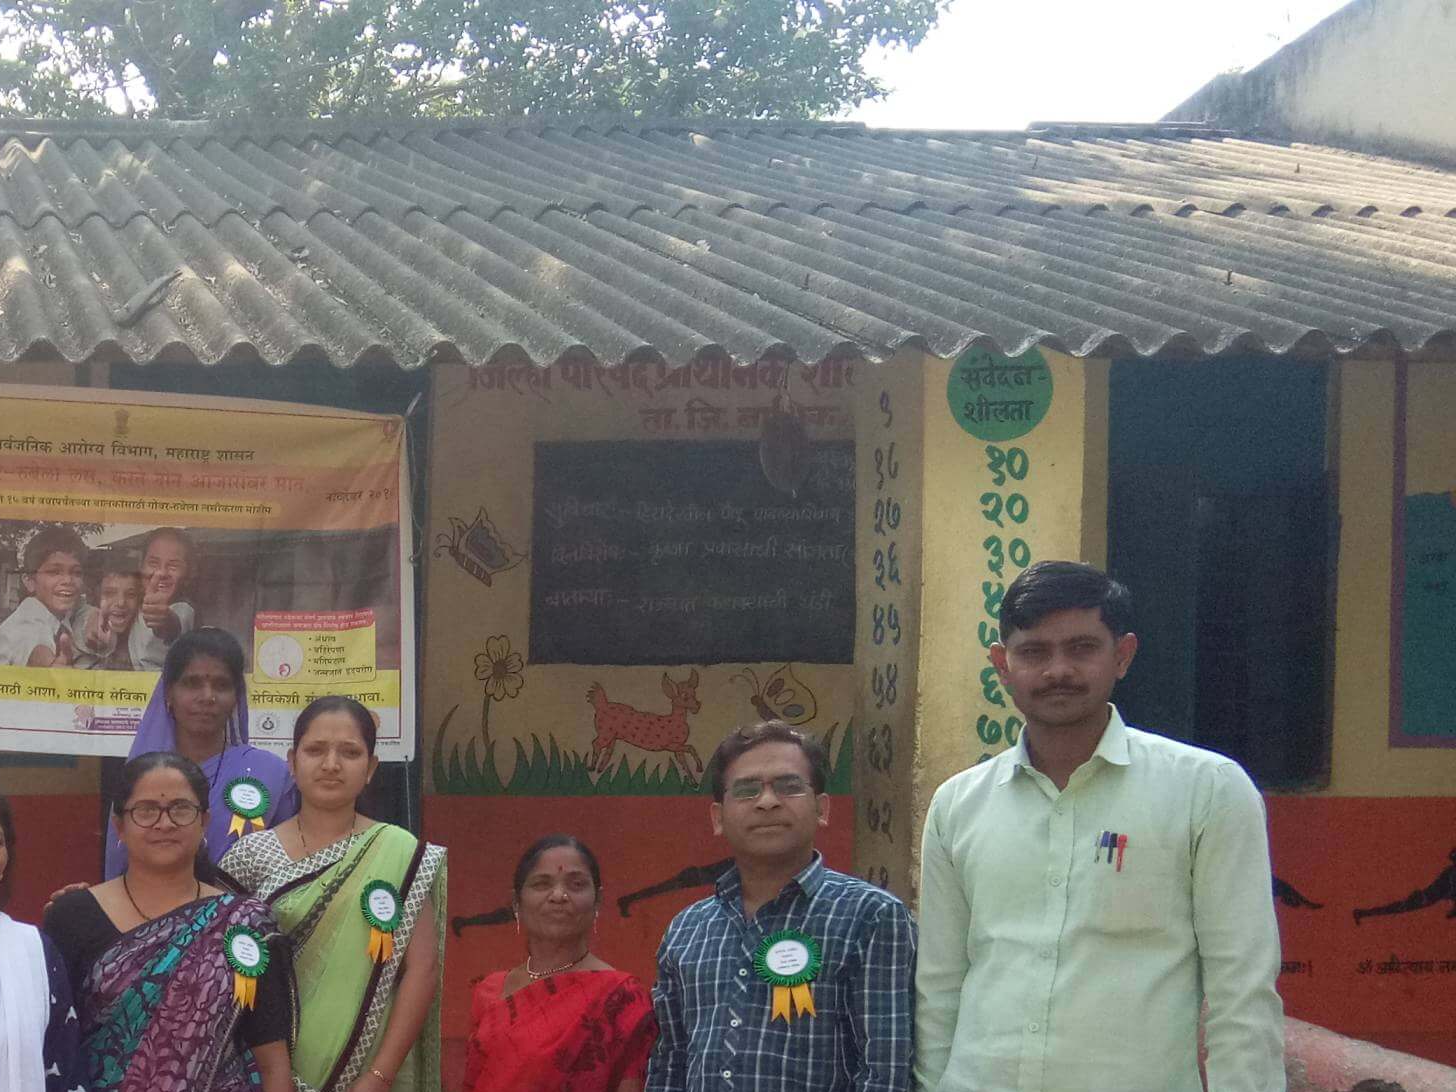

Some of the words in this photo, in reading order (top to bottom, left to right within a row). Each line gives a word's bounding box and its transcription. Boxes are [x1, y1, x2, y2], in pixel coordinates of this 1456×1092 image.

[60, 439, 105, 456] आरोग्य
[111, 441, 158, 460] विभाग,
[165, 446, 210, 462] महाराष्ट्र
[216, 449, 255, 461] शासन
[985, 444, 1029, 486] १०
[979, 491, 1029, 528] २०
[983, 534, 1031, 579] ३०
[27, 685, 62, 700] आशा,
[66, 686, 106, 702] आरोग्य
[110, 687, 147, 704] सेविका
[251, 691, 299, 706] सेविकेशी
